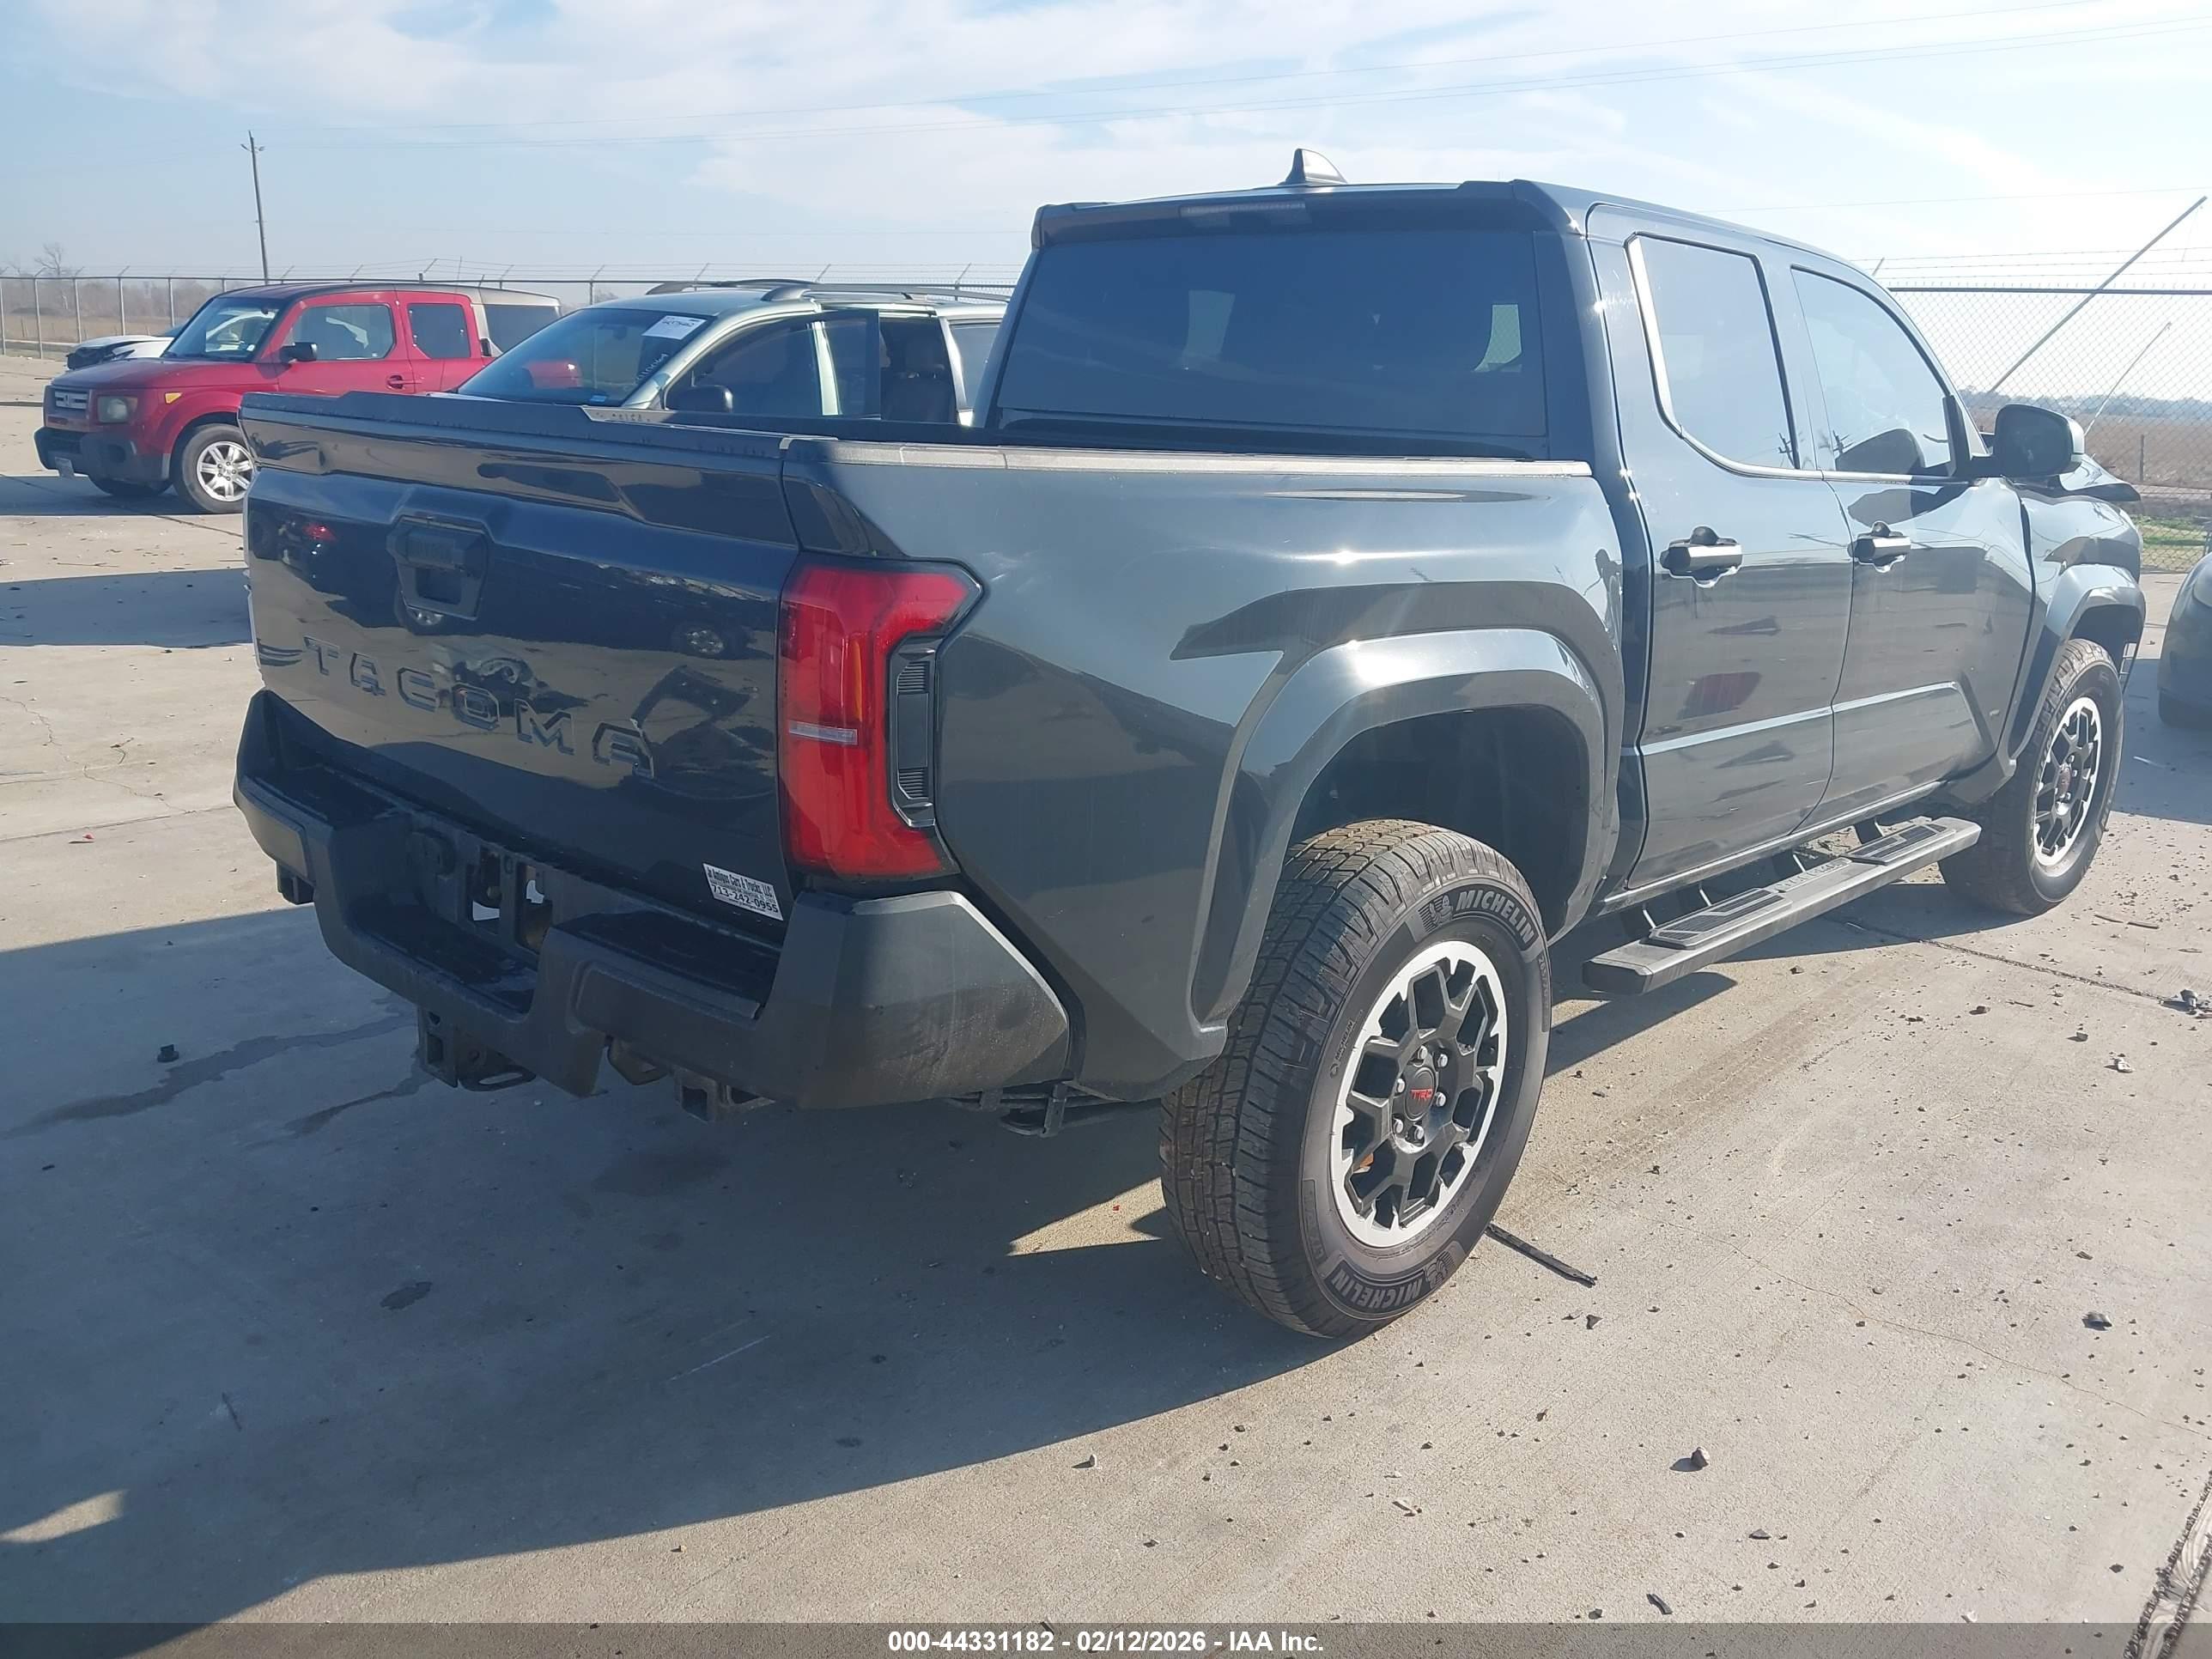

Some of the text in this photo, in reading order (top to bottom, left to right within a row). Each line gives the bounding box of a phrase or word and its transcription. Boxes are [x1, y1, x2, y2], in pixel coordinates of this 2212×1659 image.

[303, 635, 655, 778] TACOMA
[711, 884, 779, 914] 713-242-0955
[1455, 890, 1535, 945] MICHELIN
[1411, 1088, 1433, 1100] TRD
[1330, 1268, 1423, 1309] MICHELIN
